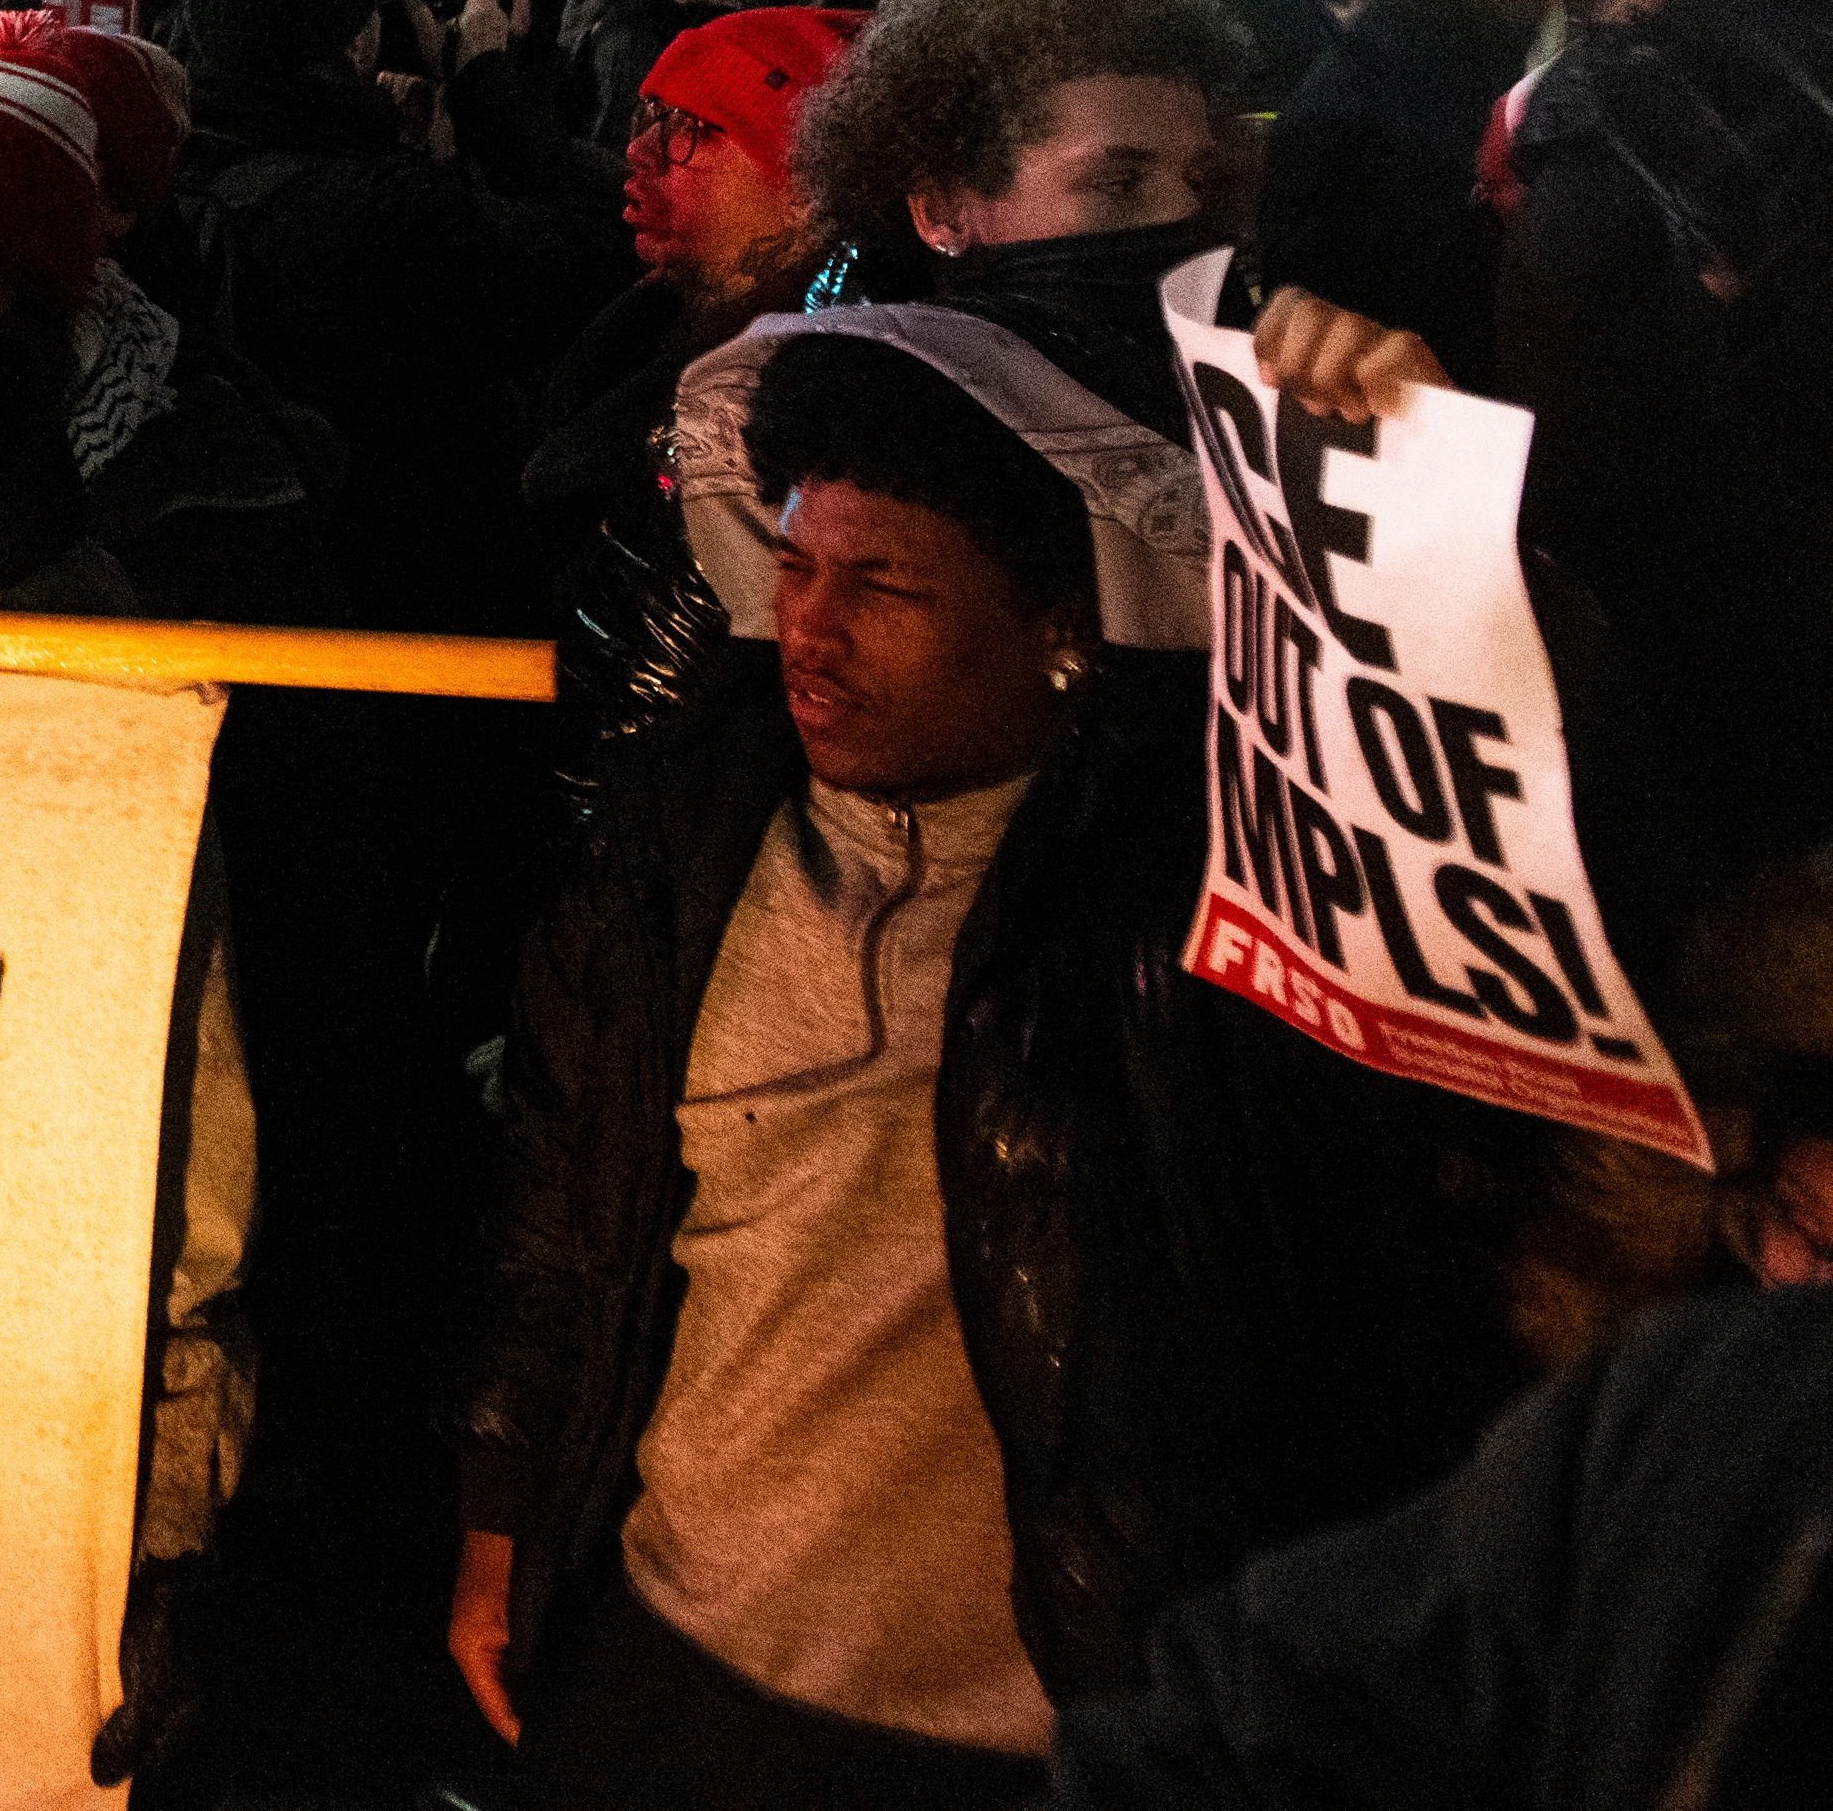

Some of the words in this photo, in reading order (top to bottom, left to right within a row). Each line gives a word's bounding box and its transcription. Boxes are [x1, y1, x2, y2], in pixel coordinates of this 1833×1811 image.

[1208, 914, 1368, 1053] FRSO
[1218, 698, 1644, 1067] MPLS!
[1222, 538, 1334, 800] OUT
[1347, 676, 1527, 1071] OF
